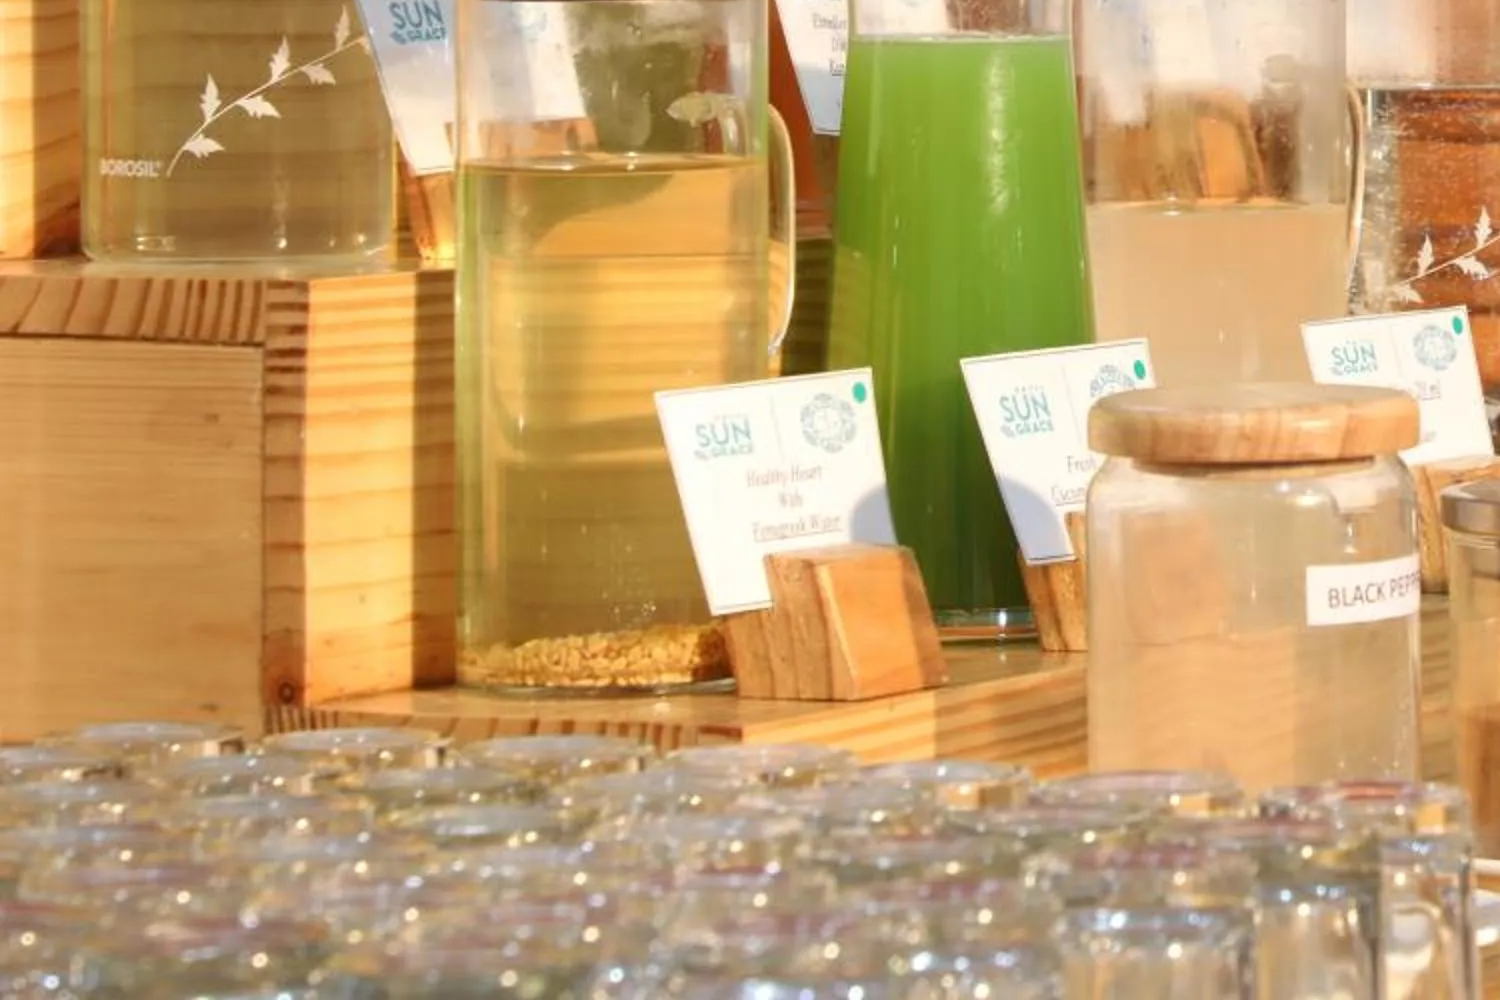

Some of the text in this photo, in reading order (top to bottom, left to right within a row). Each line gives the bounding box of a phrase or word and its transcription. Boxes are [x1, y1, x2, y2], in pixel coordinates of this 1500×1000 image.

[389, 0, 444, 30] SUN
[1330, 342, 1378, 366] SUN
[998, 391, 1052, 423] SUN
[695, 418, 752, 448] SUN
[1327, 581, 1388, 610] BLACK
